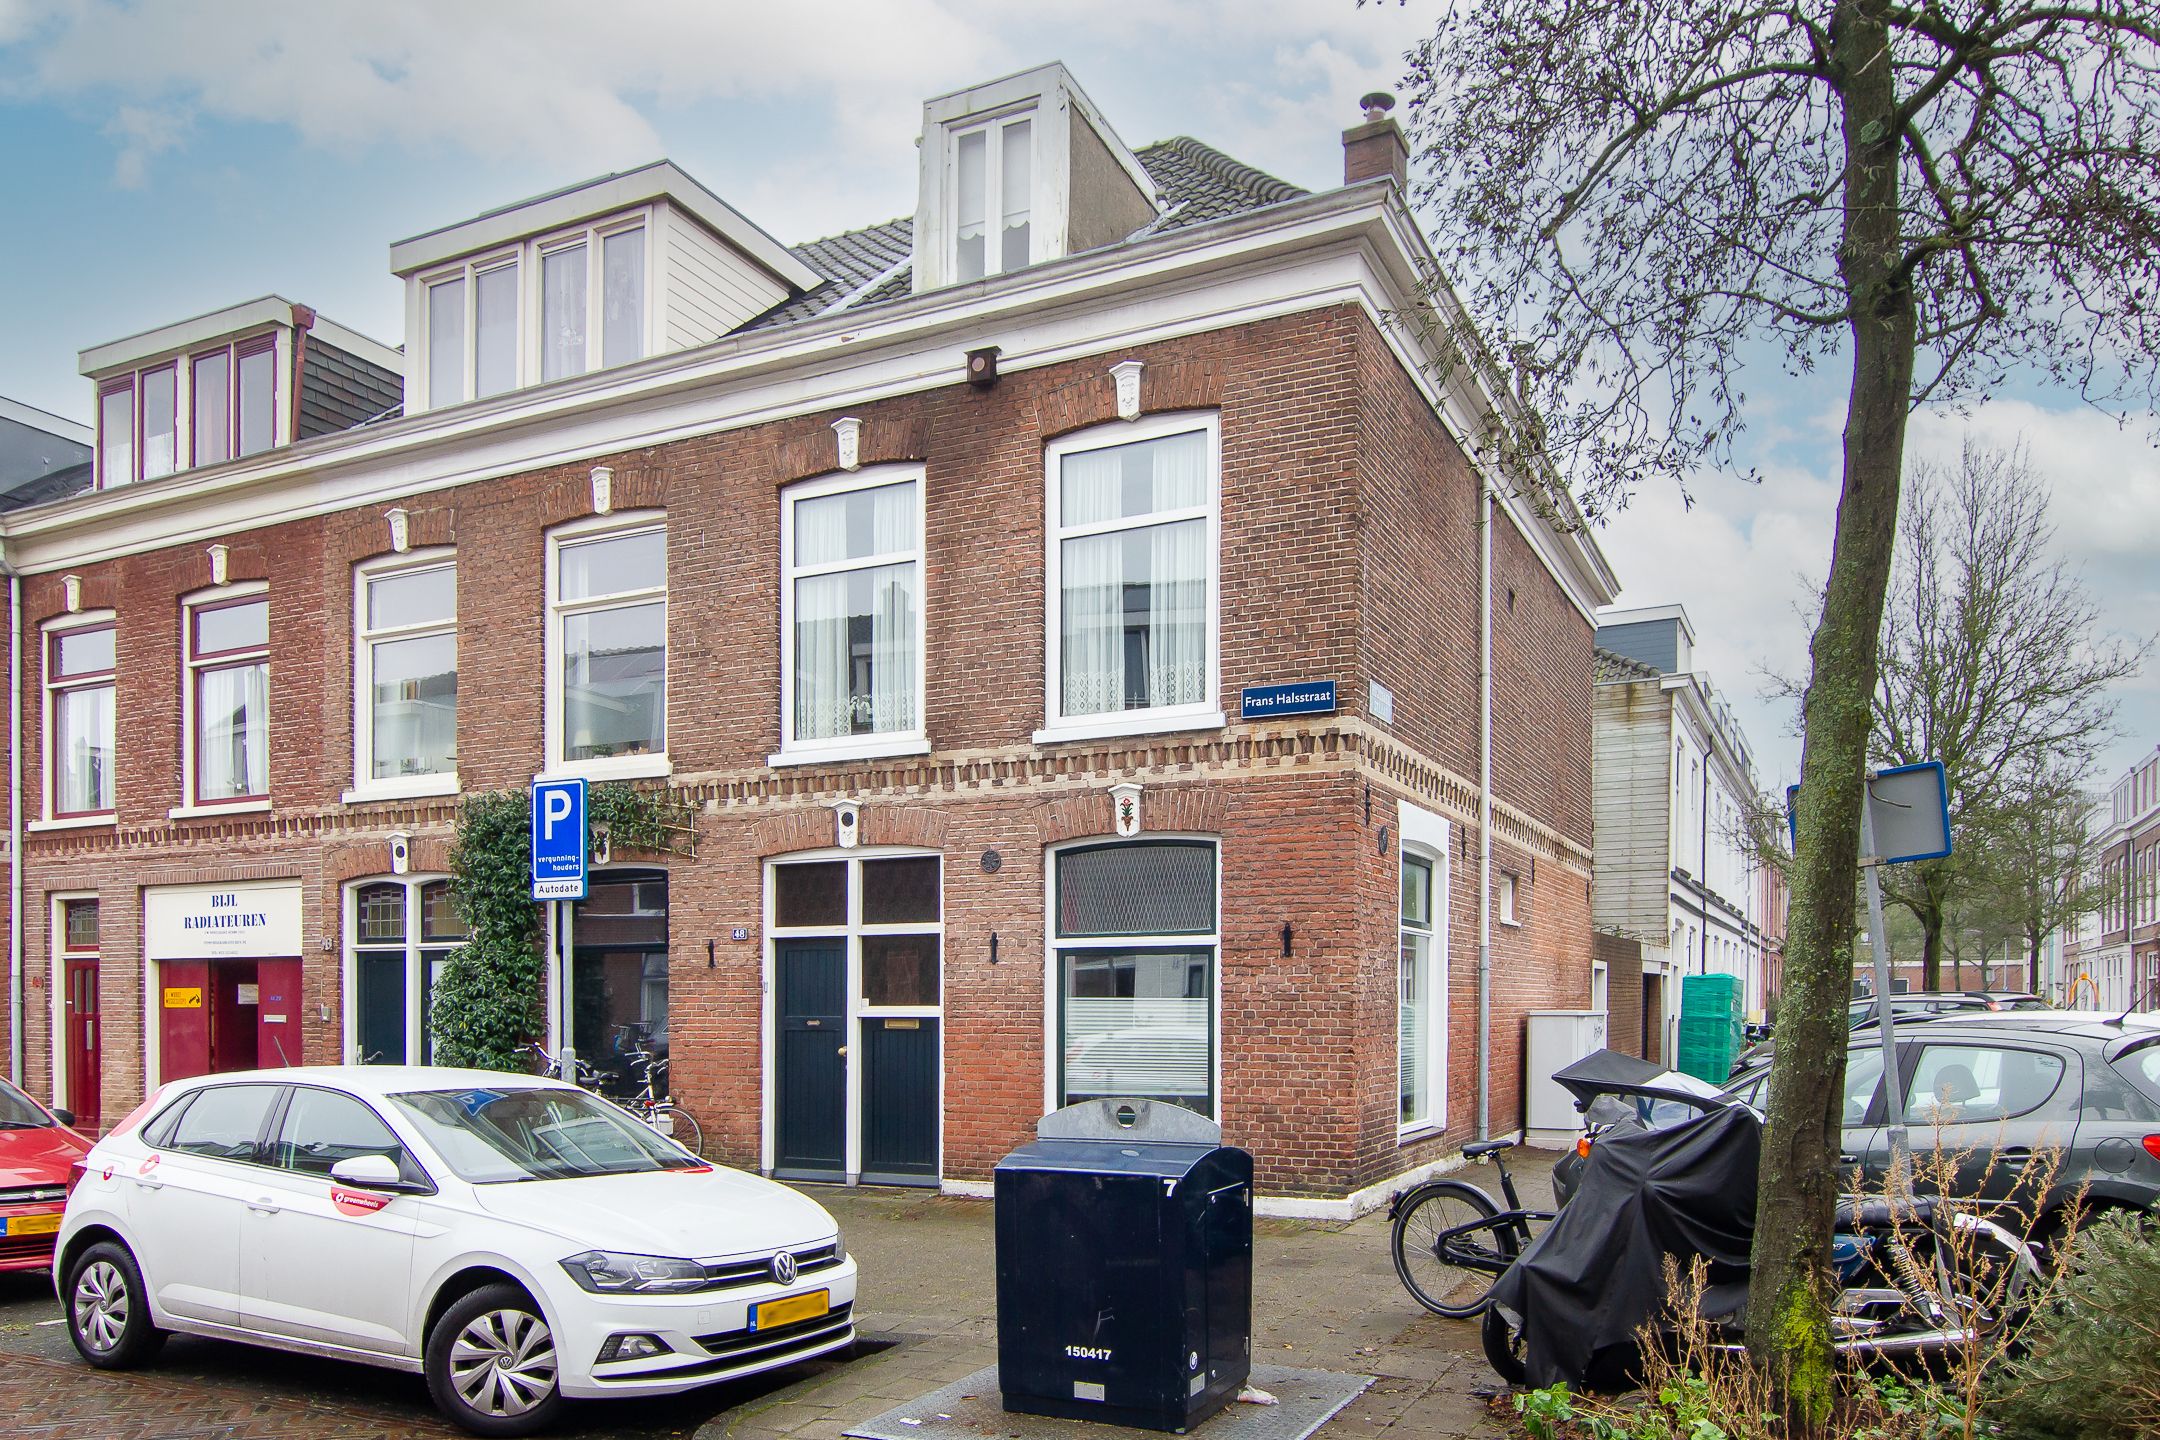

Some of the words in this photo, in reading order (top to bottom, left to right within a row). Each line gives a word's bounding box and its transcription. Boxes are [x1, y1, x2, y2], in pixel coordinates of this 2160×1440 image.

[1245, 696, 1274, 708] Frans
[1276, 691, 1331, 705] Halsstraat
[544, 789, 572, 840] P
[538, 855, 579, 864] vergunning-
[538, 884, 579, 894] Autodate
[211, 893, 238, 908] BIJL
[184, 913, 266, 929] RADIATEUREN
[735, 929, 745, 938] 48
[1163, 1179, 1178, 1197] 7
[1065, 1345, 1112, 1360] 150417
